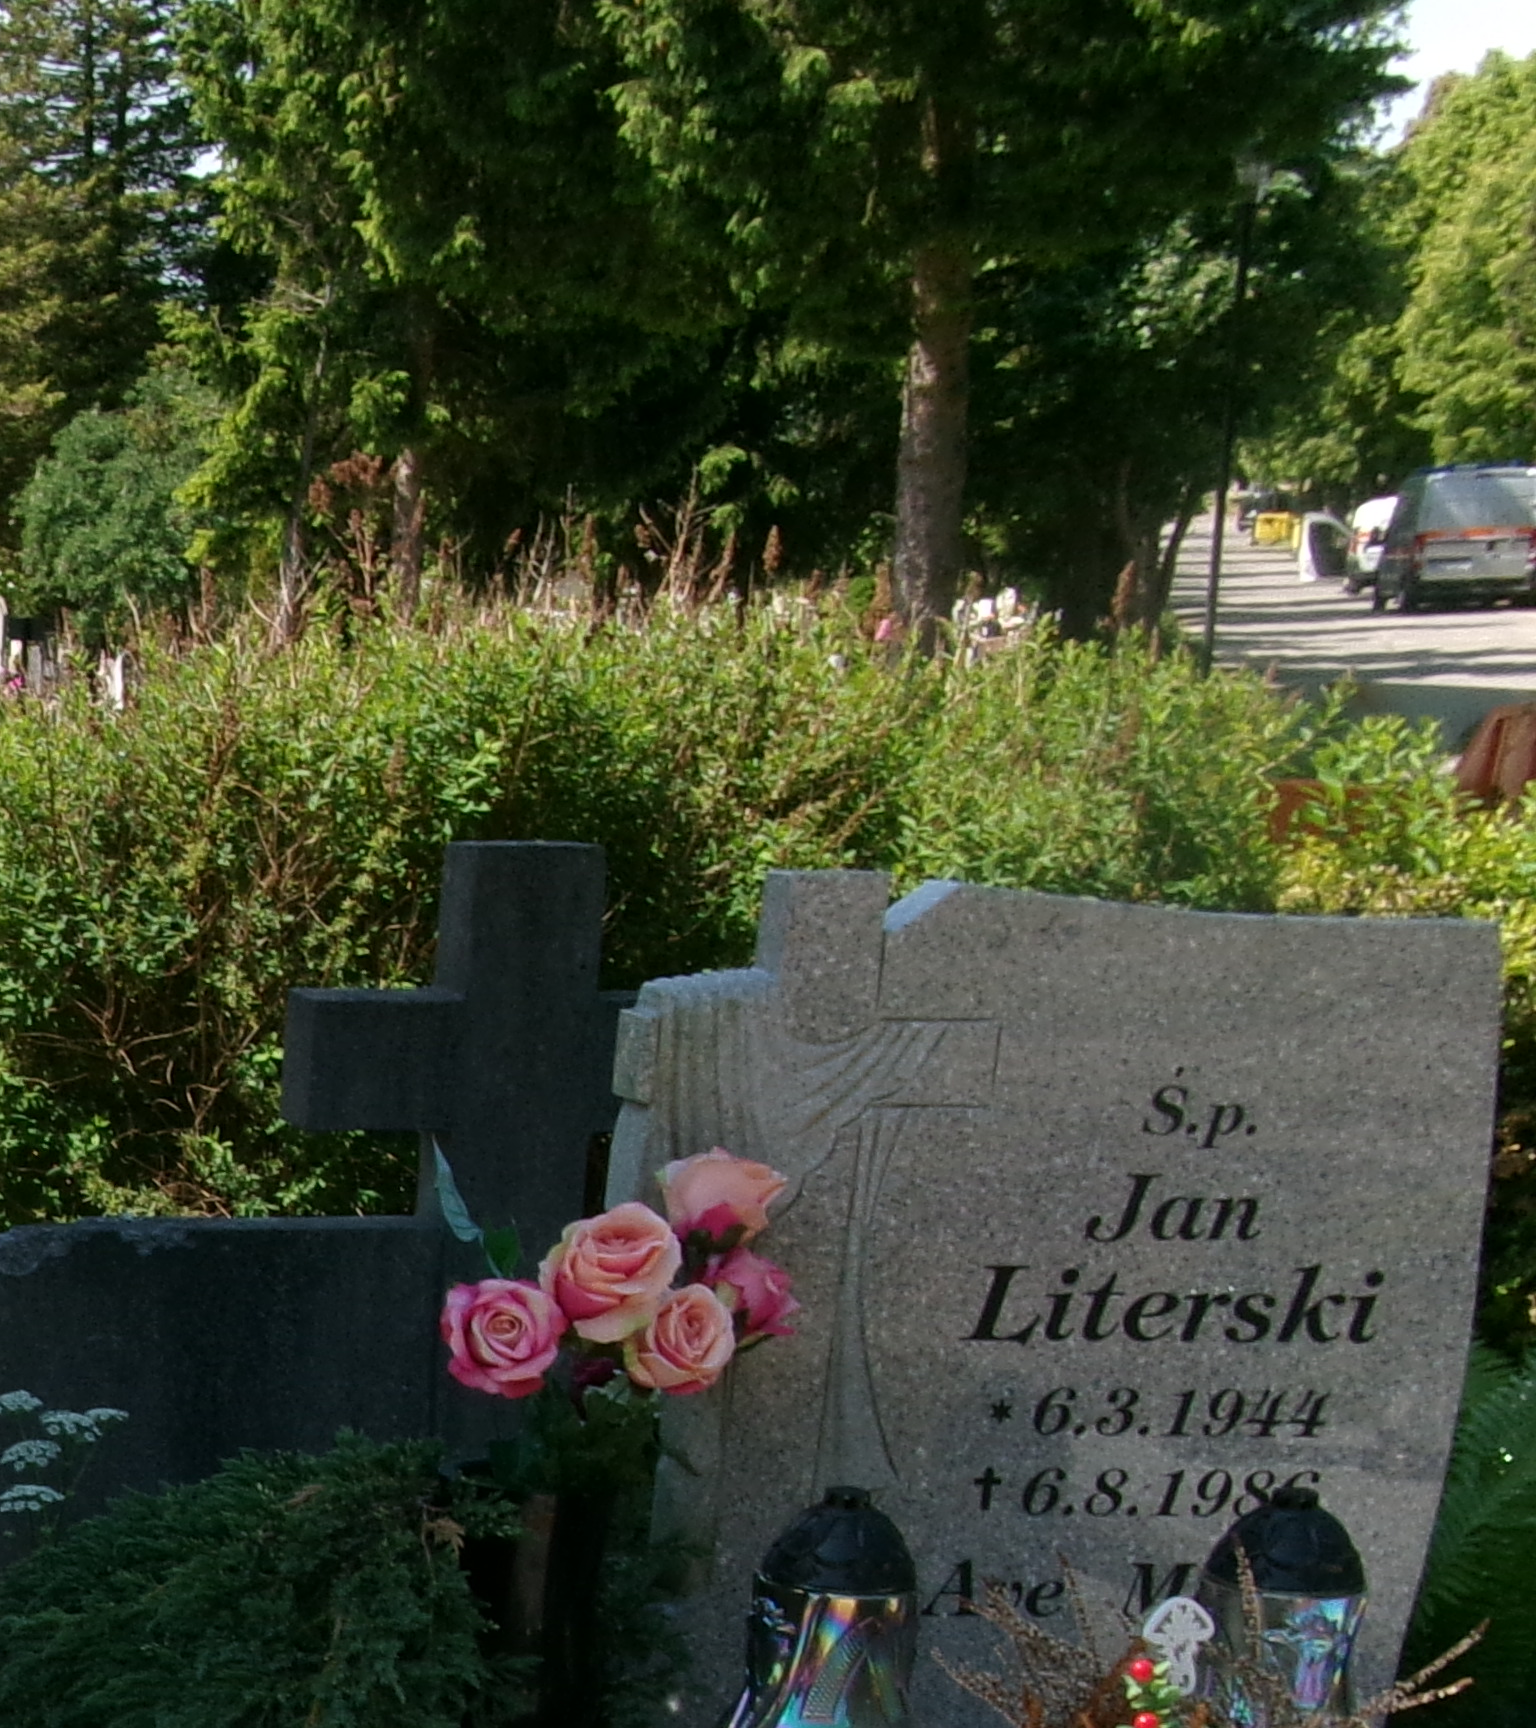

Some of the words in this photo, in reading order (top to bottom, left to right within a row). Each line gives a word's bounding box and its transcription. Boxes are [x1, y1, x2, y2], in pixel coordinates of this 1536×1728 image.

[1141, 1066, 1258, 1149] Ś.p.
[1085, 1173, 1262, 1243] Jan
[961, 1263, 1385, 1346] Literski
